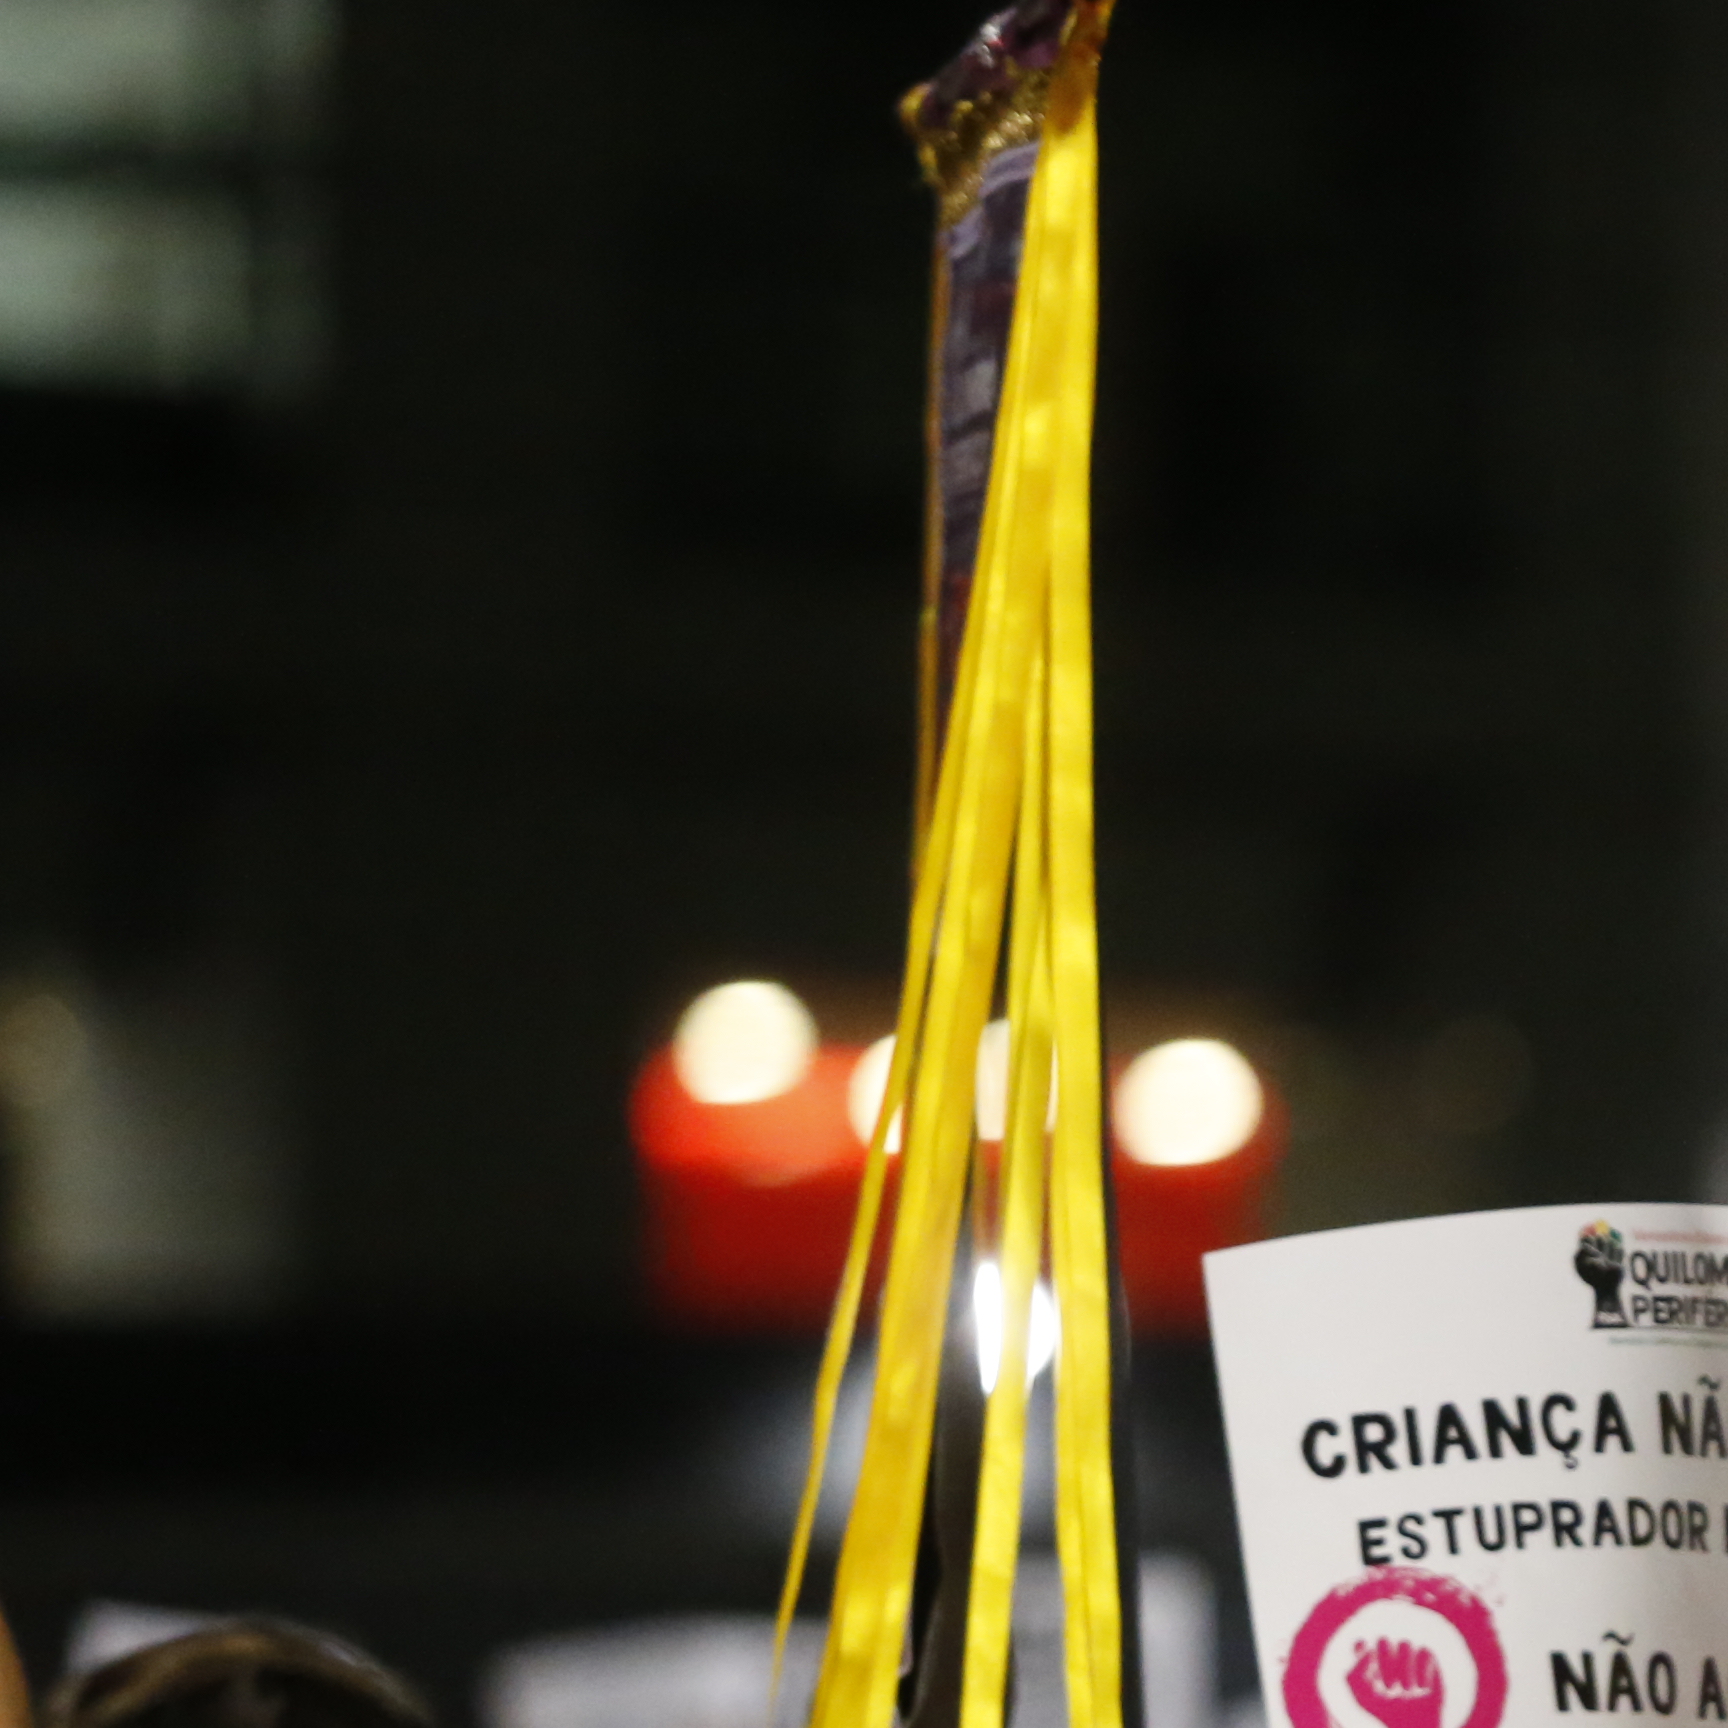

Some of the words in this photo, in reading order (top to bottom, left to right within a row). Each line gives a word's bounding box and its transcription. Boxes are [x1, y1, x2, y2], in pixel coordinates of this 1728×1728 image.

[1300, 1390, 1635, 1478] CRIANÇA
[1357, 1497, 1711, 1566] ESTUPRADOR
[1549, 1631, 1678, 1716] NÃO
